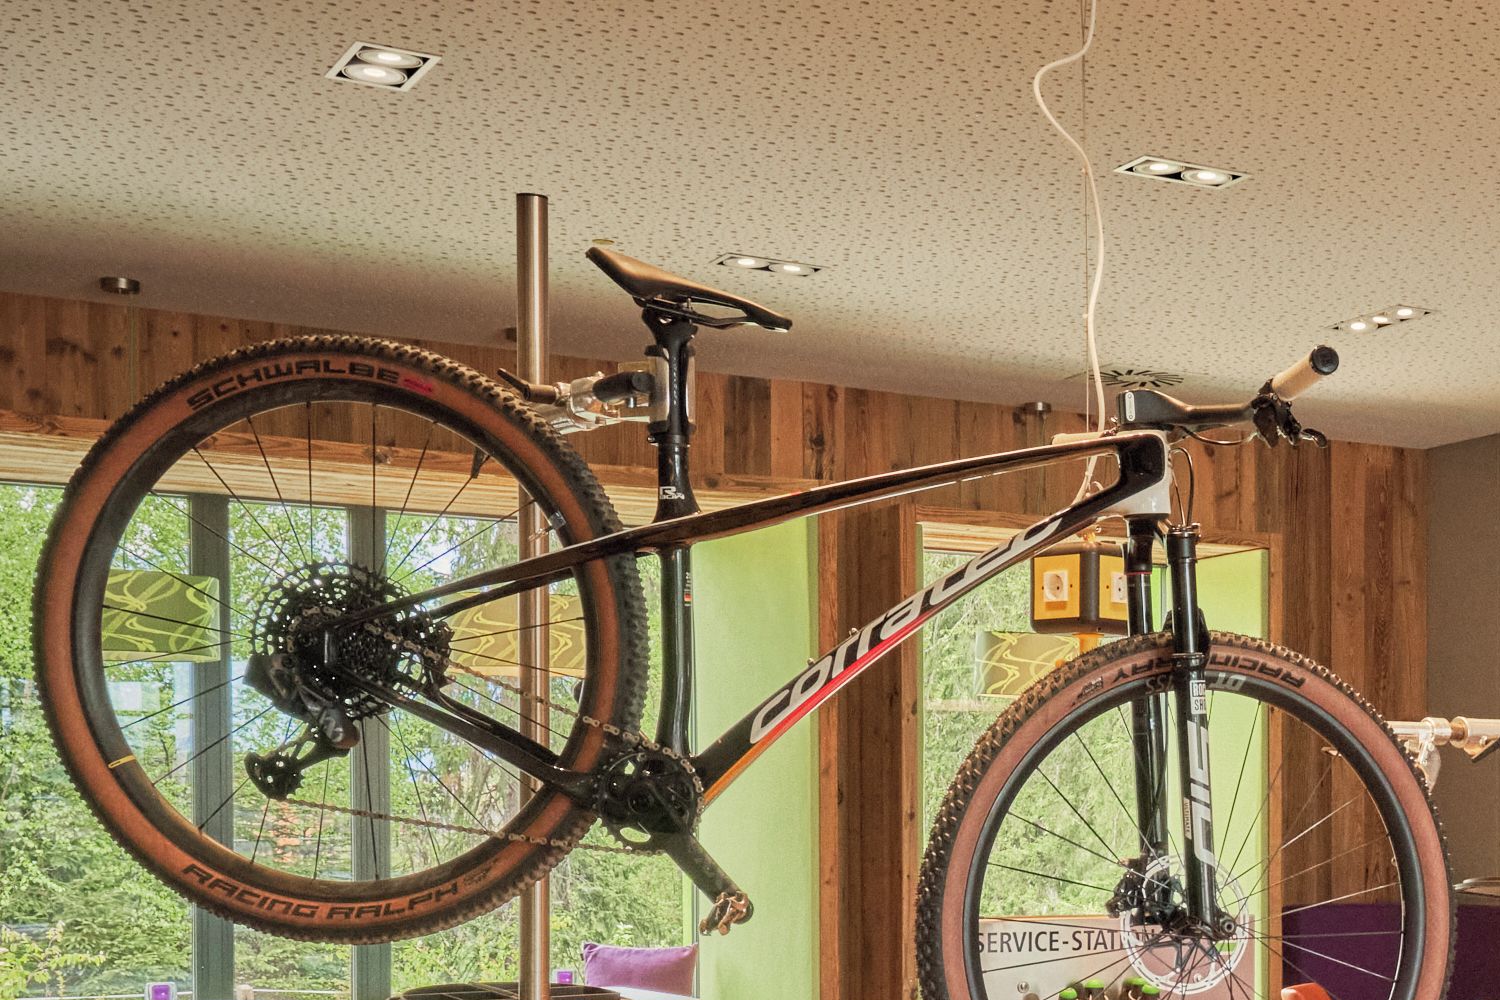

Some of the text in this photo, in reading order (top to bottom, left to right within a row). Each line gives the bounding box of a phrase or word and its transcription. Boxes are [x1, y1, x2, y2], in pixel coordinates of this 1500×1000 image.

[186, 360, 399, 411] SCHWALBE
[750, 517, 1064, 744] corratec
[181, 863, 458, 920] RACING RALPH
